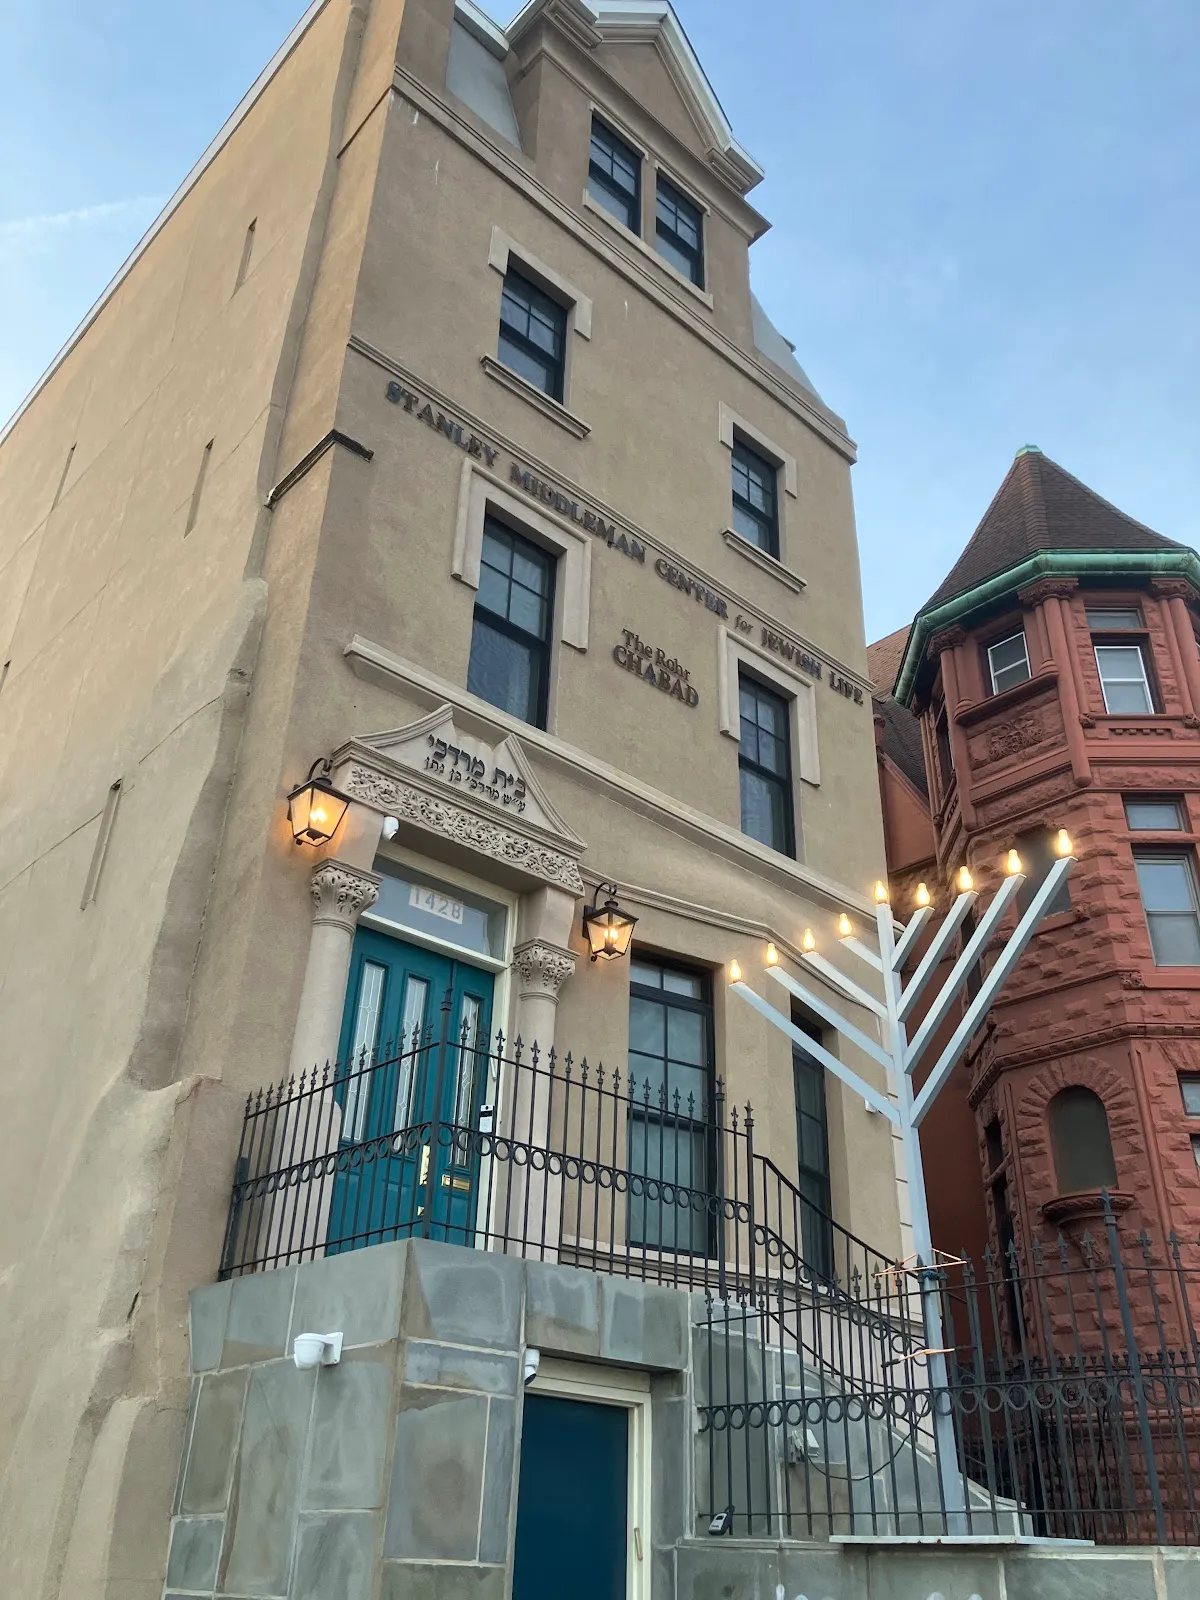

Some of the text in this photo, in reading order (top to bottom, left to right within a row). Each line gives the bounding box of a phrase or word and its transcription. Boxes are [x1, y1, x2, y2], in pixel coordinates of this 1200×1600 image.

[386, 380, 864, 706] STANLEY MIDDLEMAN CENTER for JEWISH LIFE
[612, 644, 699, 708] CHABAD
[622, 628, 691, 681] The Rohr
[427, 734, 526, 798] בית מרדכי
[414, 887, 461, 919] 1428
